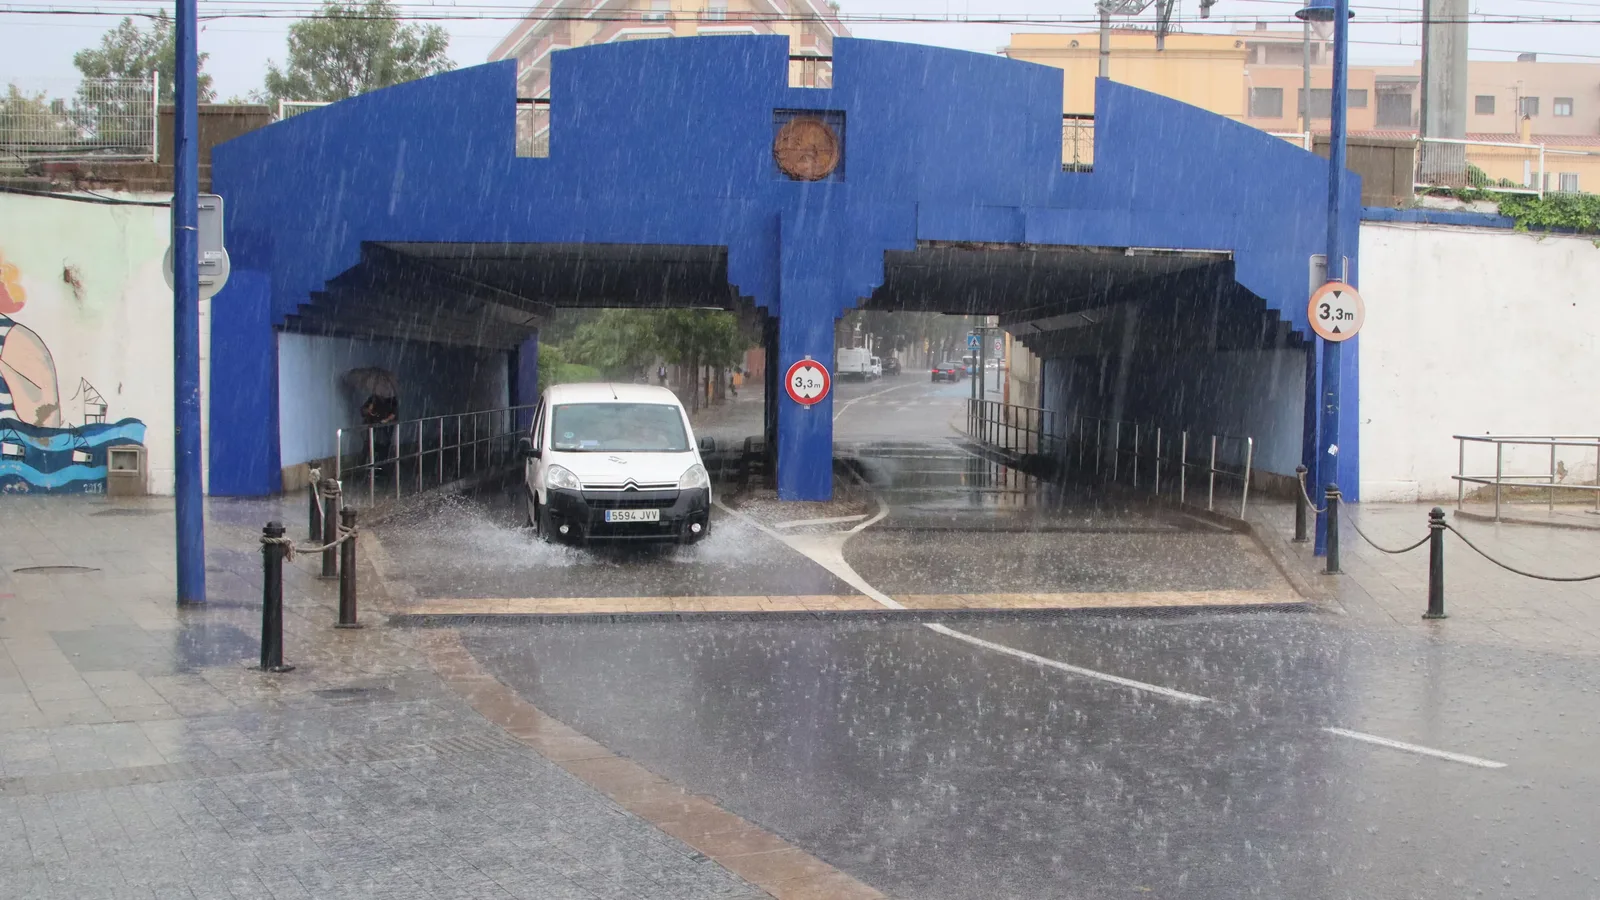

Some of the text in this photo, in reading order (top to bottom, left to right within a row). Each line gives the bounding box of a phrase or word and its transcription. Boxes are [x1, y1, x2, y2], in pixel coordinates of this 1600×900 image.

[1319, 303, 1354, 321] 3,3m
[795, 376, 821, 390] 3,3m
[612, 510, 657, 520] 5594 JVV
